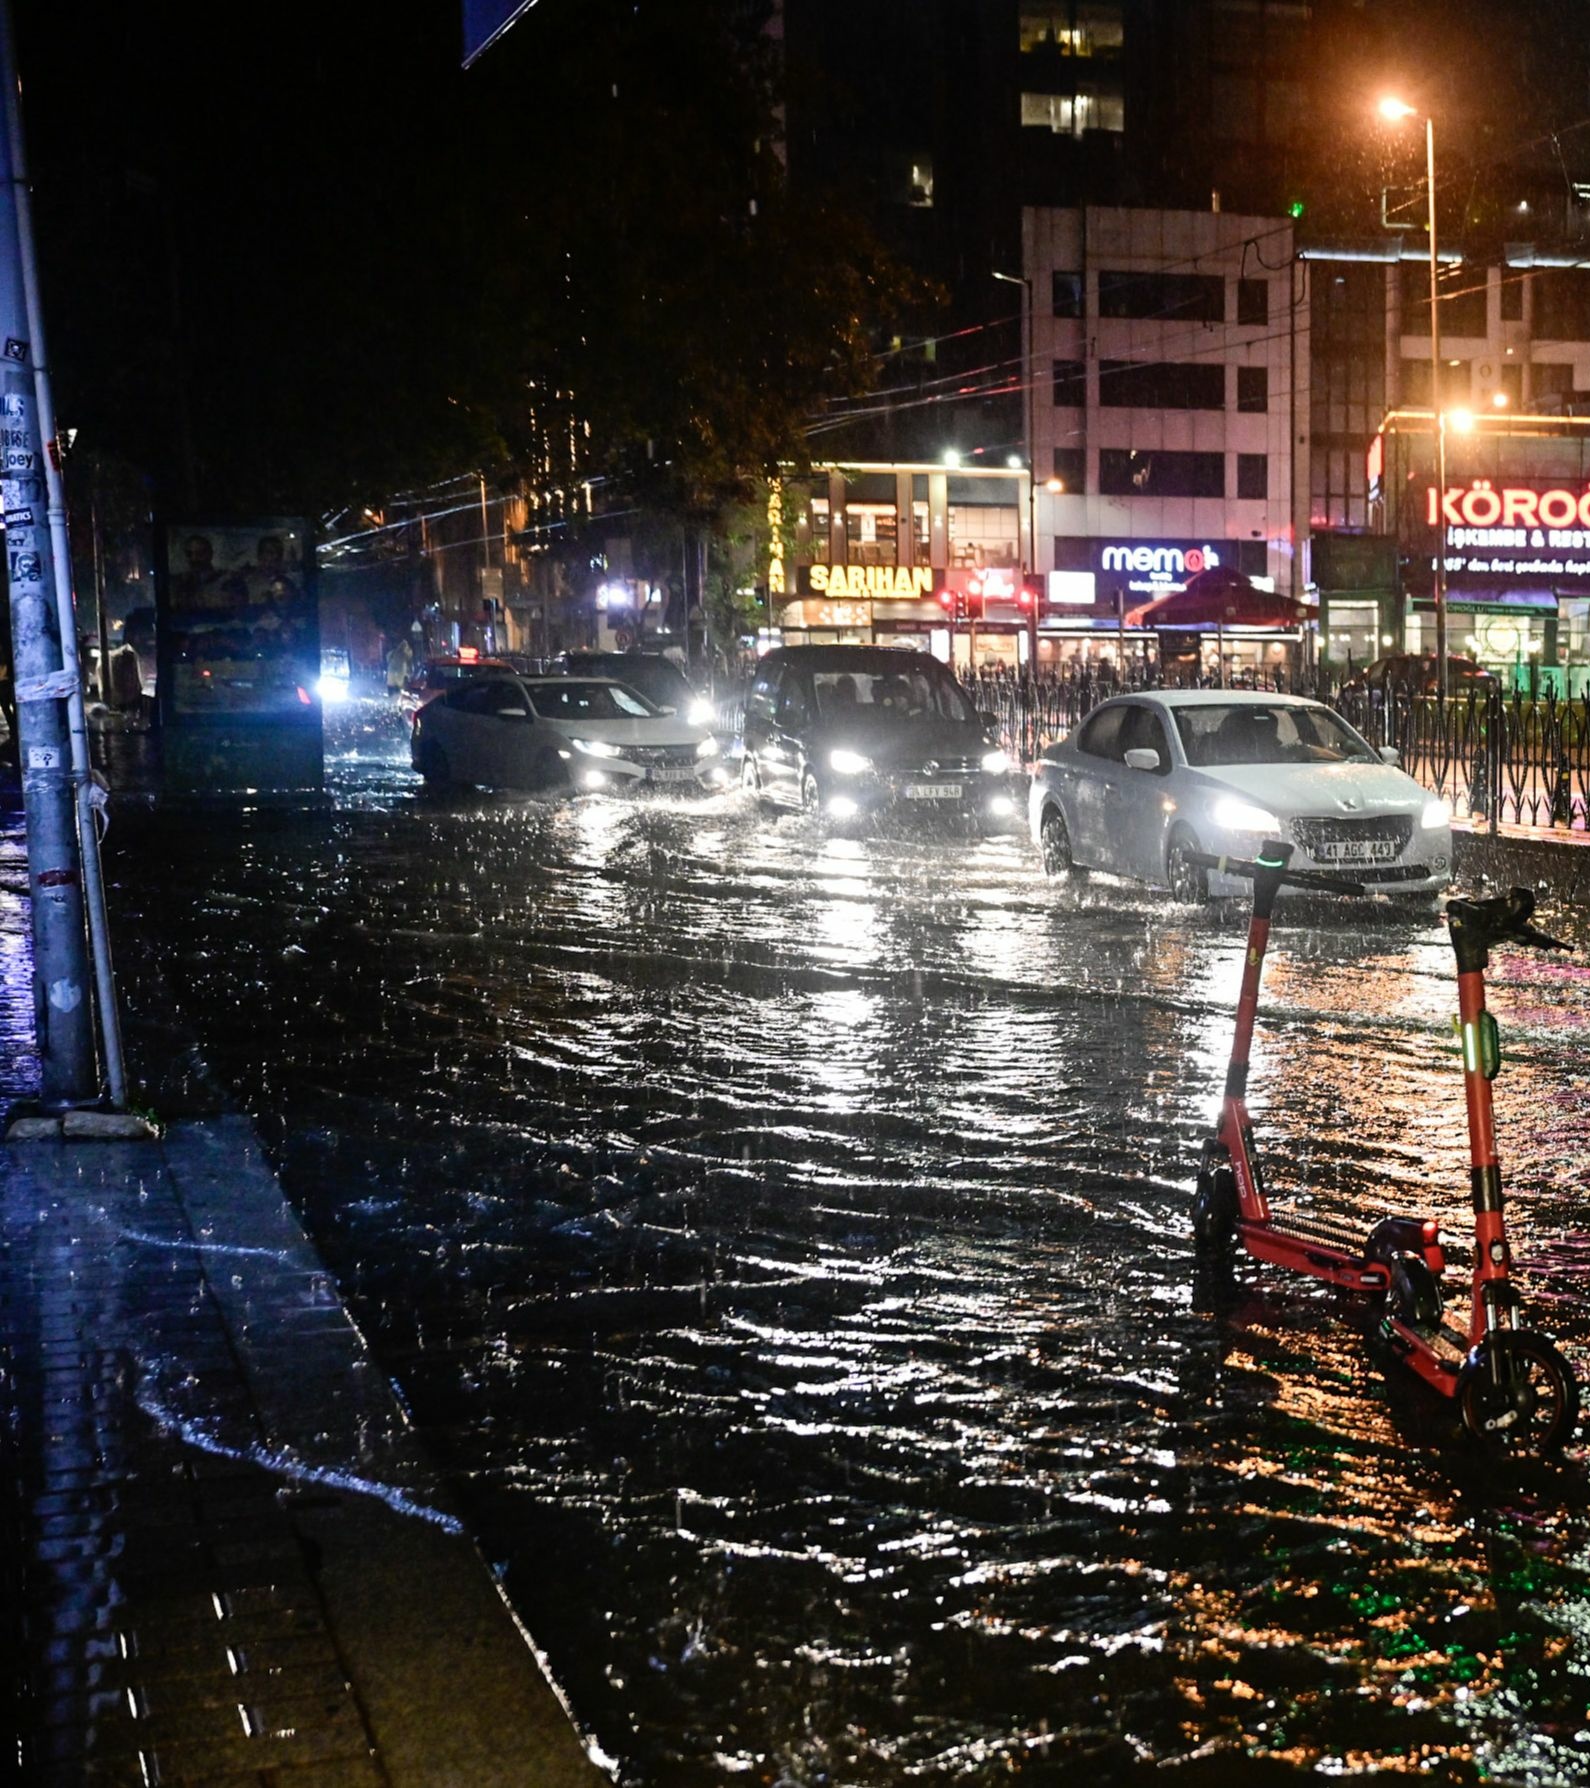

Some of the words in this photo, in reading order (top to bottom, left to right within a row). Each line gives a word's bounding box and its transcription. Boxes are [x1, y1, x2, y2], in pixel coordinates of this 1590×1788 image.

[1447, 526, 1527, 549] İŞKEMBE
[1530, 529, 1545, 548] &
[810, 565, 932, 592] SARIHAN
[1327, 845, 1338, 857] 41
